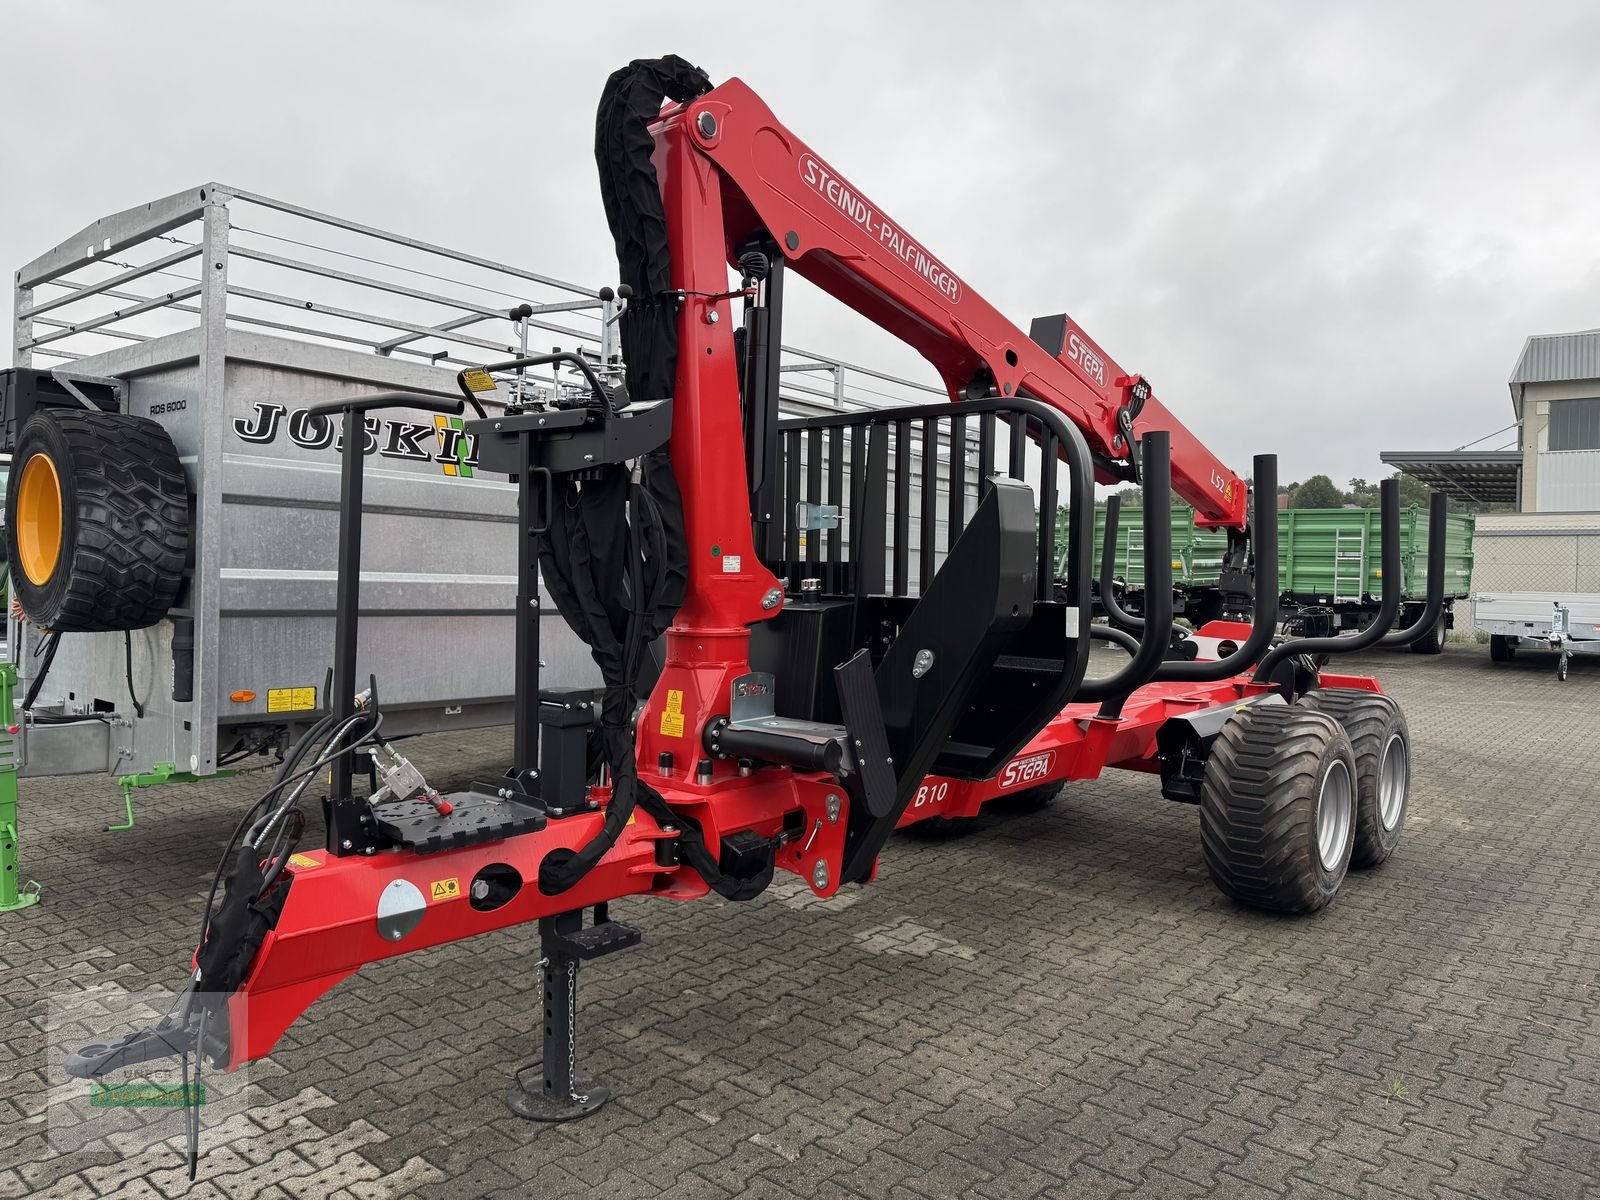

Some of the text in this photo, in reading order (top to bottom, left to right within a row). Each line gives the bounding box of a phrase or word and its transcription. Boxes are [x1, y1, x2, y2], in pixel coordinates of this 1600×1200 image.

[804, 159, 958, 300] STEINDL-PALFINGER
[1067, 333, 1104, 386] STEPA
[150, 399, 187, 415] RDS 6000
[232, 401, 480, 467] JOKI
[1002, 758, 1050, 787] STEPA
